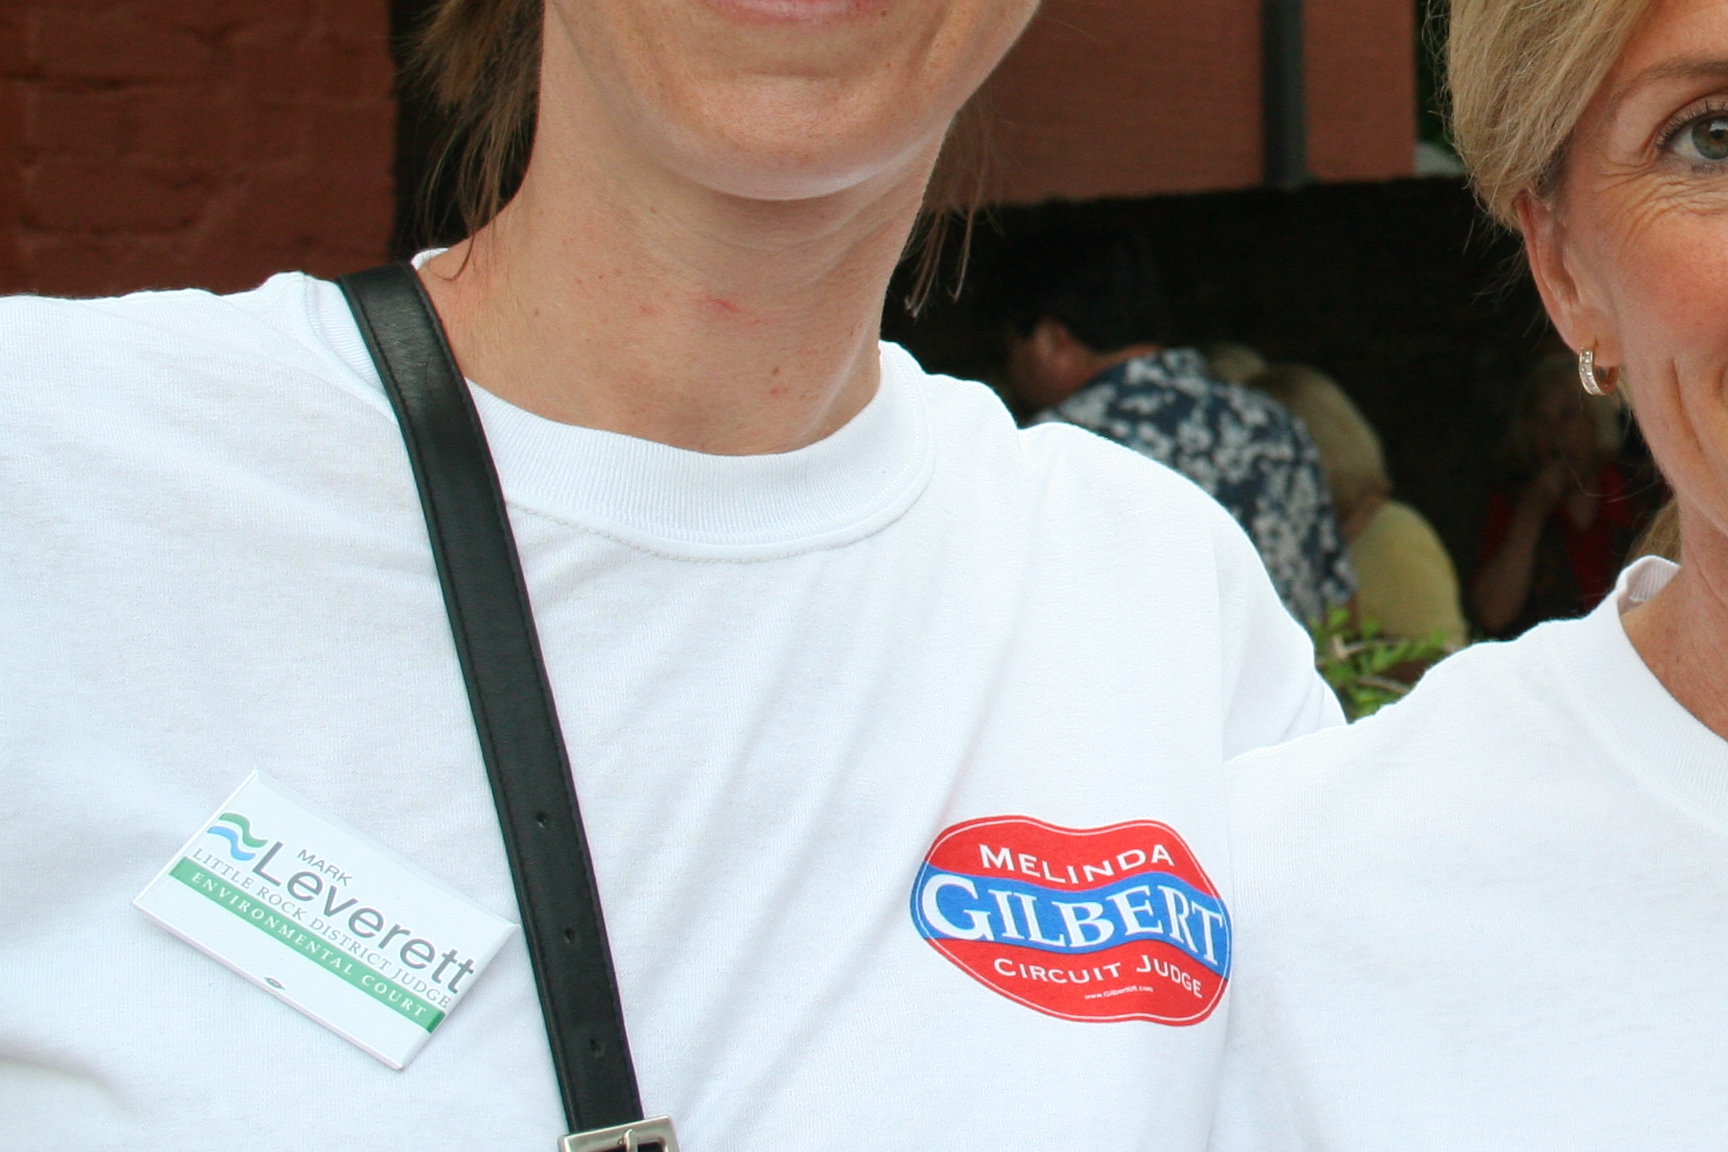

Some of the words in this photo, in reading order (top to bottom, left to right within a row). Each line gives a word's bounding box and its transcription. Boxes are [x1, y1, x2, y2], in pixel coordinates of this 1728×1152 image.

[297, 849, 353, 887] MARK
[978, 843, 1175, 884] MELINDA
[192, 872, 353, 975] ENVIRONMENTAL
[361, 974, 427, 1017] COURT
[193, 848, 255, 888] LITTLE
[257, 886, 307, 921] ROCK
[309, 917, 392, 971] DISTRICT
[391, 968, 452, 1008] JUDGE
[252, 841, 475, 994] Leverett
[922, 873, 1223, 965] GILBERT
[994, 958, 1121, 984] CIRCUIT
[1136, 954, 1203, 998] JUDGE
